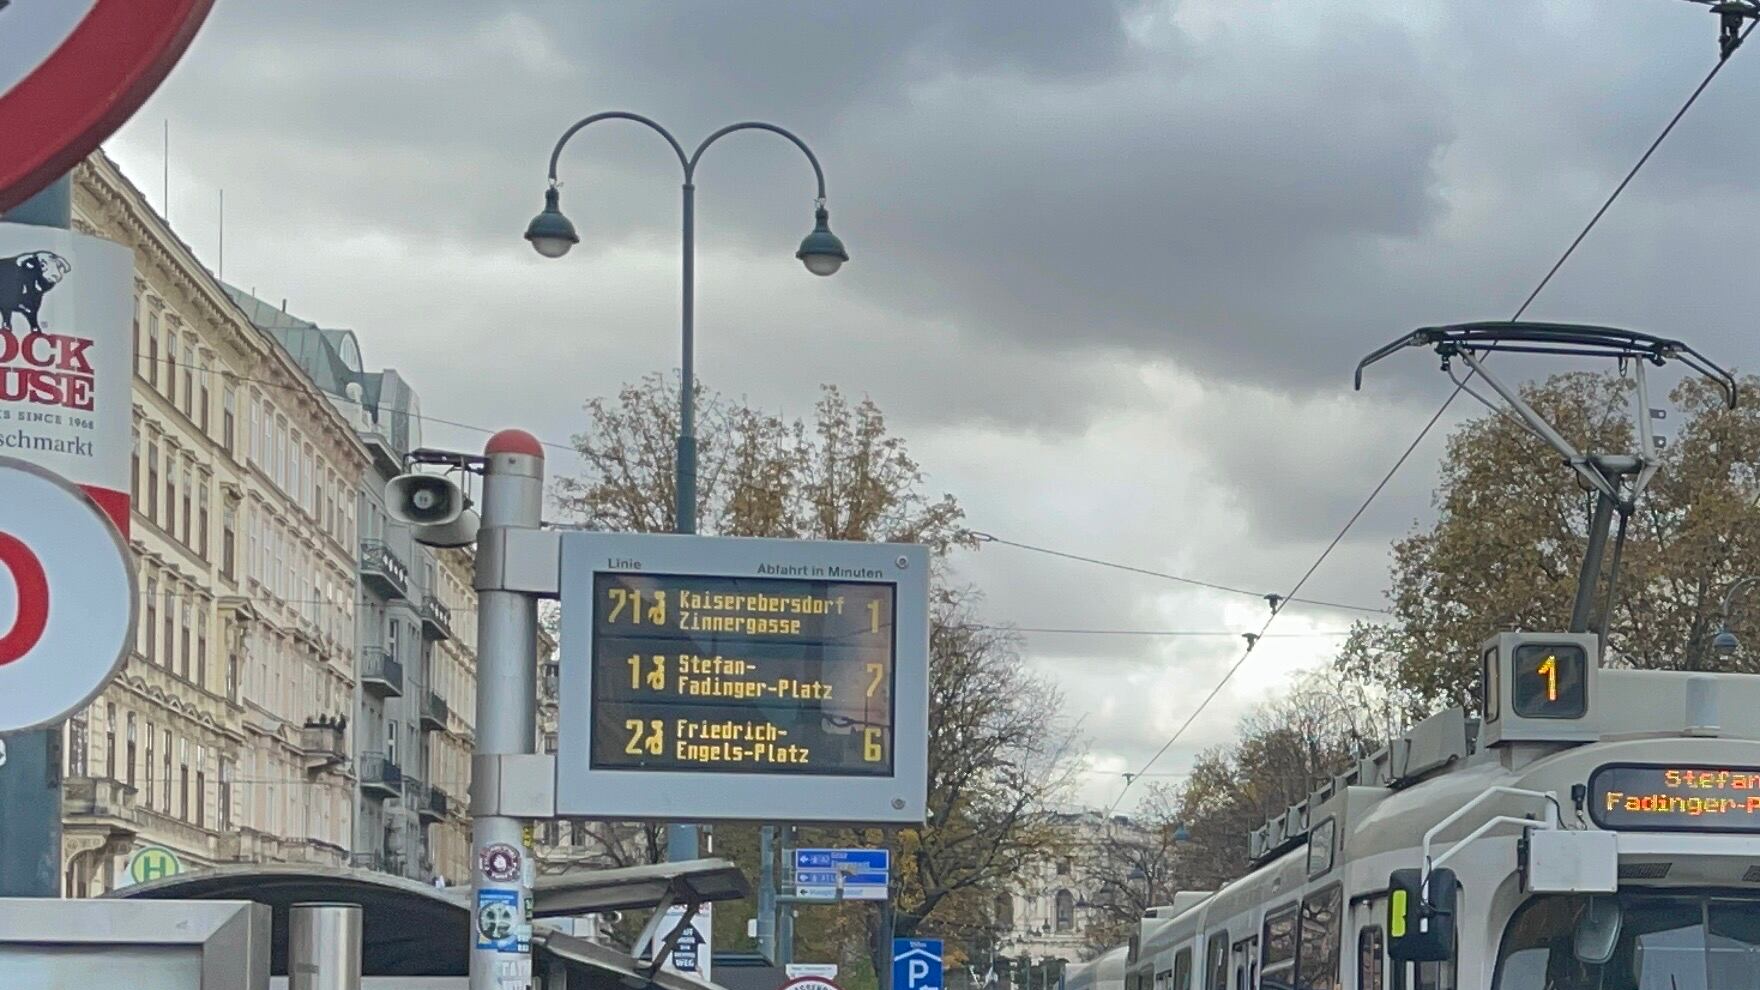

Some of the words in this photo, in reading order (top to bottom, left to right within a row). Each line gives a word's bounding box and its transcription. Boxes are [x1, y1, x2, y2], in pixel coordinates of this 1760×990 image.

[18, 410, 62, 425] SINCE
[608, 557, 642, 570] Linie
[757, 562, 808, 577] Abfahrt
[811, 564, 824, 577] in
[828, 565, 883, 579] Minuten
[608, 588, 642, 624] 71
[679, 590, 845, 615] Kaiserebersdorf
[867, 600, 880, 633] 1
[679, 611, 801, 635] Zinnergasse
[626, 654, 641, 689] 1
[678, 654, 757, 676] Stefan-
[1537, 655, 1557, 701] 1
[677, 676, 833, 700] Fadinger-Platz
[625, 719, 644, 754] 2
[676, 719, 788, 741] Friedrich-
[864, 727, 882, 762] 6
[676, 741, 809, 763] Engels-Platz
[909, 960, 929, 989] P
